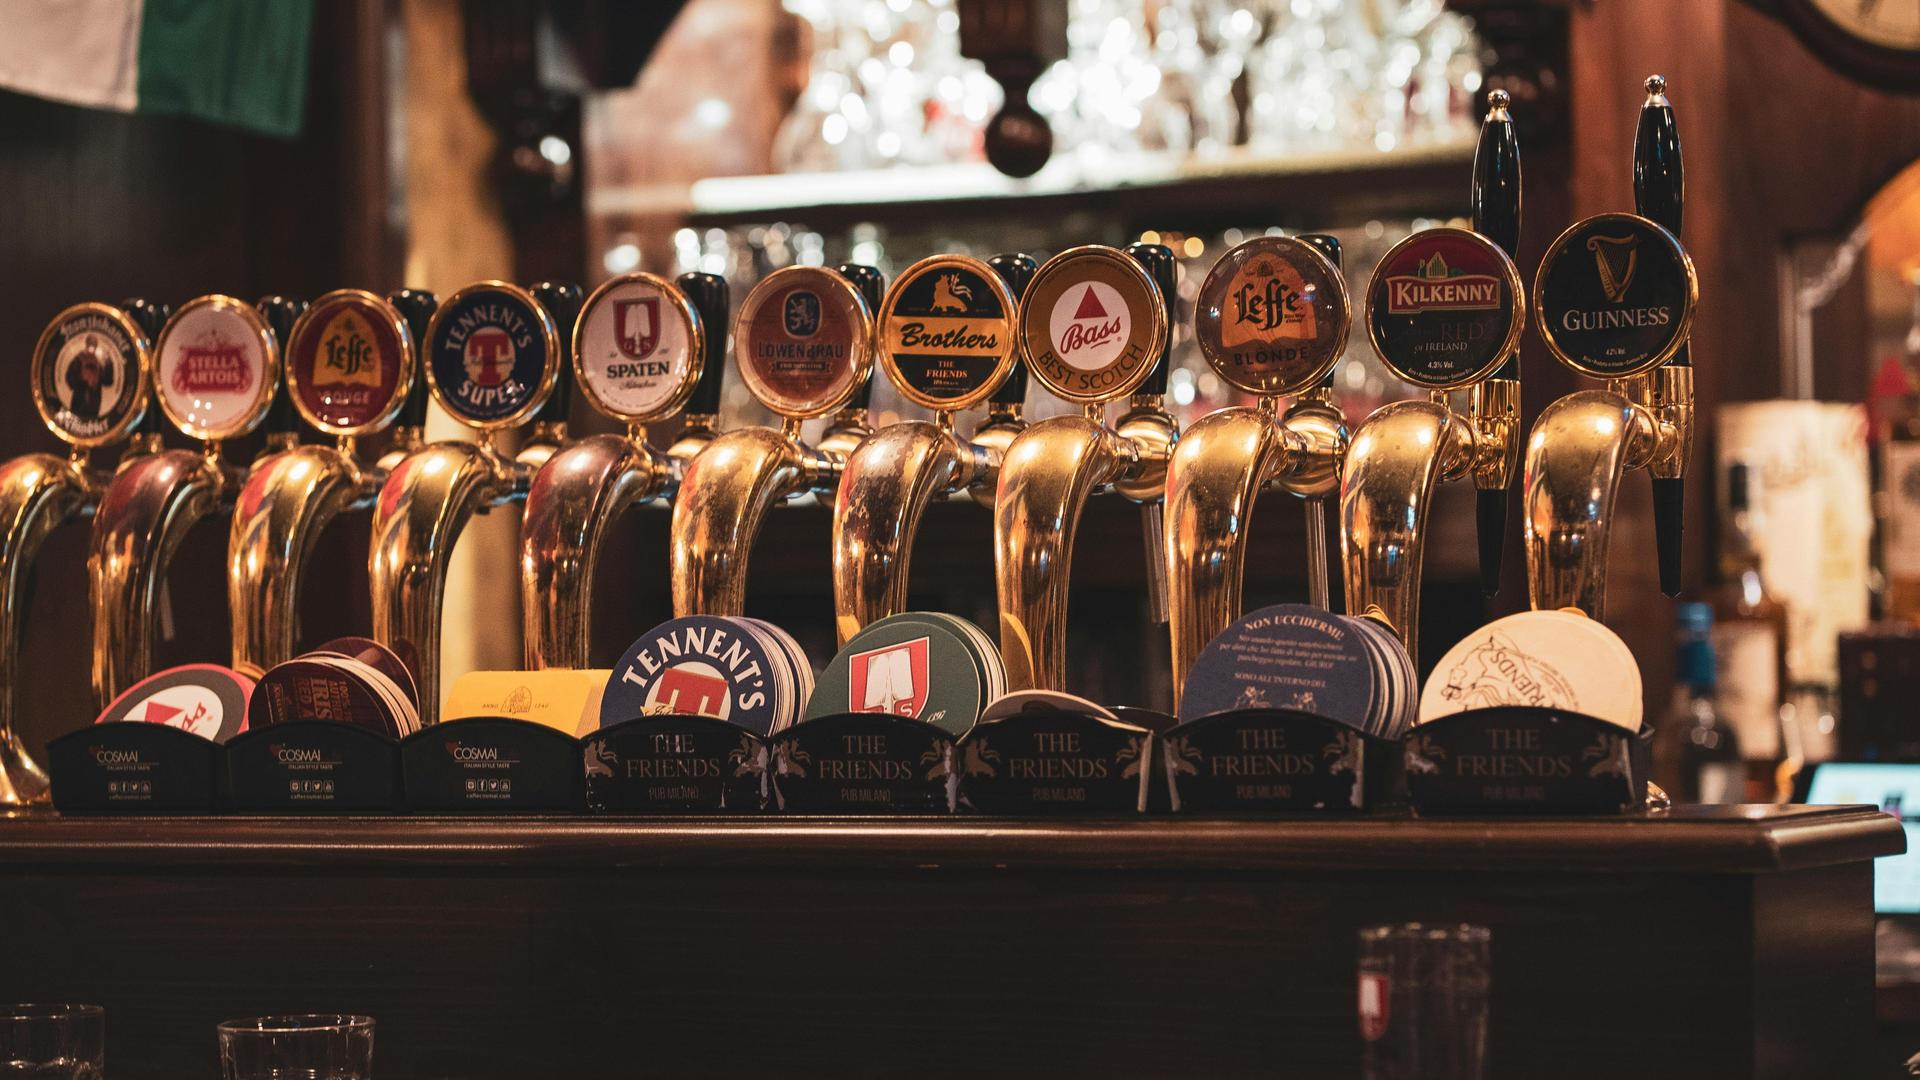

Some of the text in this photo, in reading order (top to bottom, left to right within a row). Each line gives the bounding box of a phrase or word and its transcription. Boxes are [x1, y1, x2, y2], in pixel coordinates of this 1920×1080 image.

[1396, 282, 1495, 306] KILKENNY
[1233, 278, 1300, 331] Leffe
[445, 303, 533, 351] TENNENT'S
[1563, 307, 1670, 331] GUINNESS
[899, 322, 998, 349] Brothers
[1060, 316, 1121, 355] Bass
[325, 334, 373, 375] Leffe
[1234, 346, 1310, 367] BLONDE
[1425, 341, 1468, 352] IRELAND
[188, 355, 241, 369] STELLA
[606, 361, 670, 380] SPATEN
[938, 360, 955, 368] THE
[1038, 343, 1145, 390] BEST SCOTCH
[187, 369, 241, 384] ARTOIS
[926, 369, 968, 378] FRIENDS
[457, 378, 521, 406] SUPER
[1244, 617, 1271, 631] NON
[621, 626, 766, 711] TENNENT'S
[1490, 648, 1546, 707] RIENDS
[311, 677, 332, 720] IRIS
[653, 734, 695, 753] THE
[843, 735, 888, 754] THE
[1033, 733, 1081, 752] THE
[1236, 728, 1287, 749] THE
[1485, 729, 1541, 749] THE
[97, 750, 139, 763] COSMAI
[278, 749, 321, 762] COSMAI
[453, 747, 497, 760] COSMAI
[626, 759, 721, 777] FRIENDS
[819, 760, 913, 780] FRIENDS
[1008, 758, 1108, 779] FRIENDS
[1212, 754, 1315, 776] FRIENDS
[1455, 755, 1573, 777] FRIENDS
[649, 786, 700, 800] PUB MILANO
[841, 788, 892, 801] PUB MILANO
[1032, 787, 1087, 801] PUB MILANO
